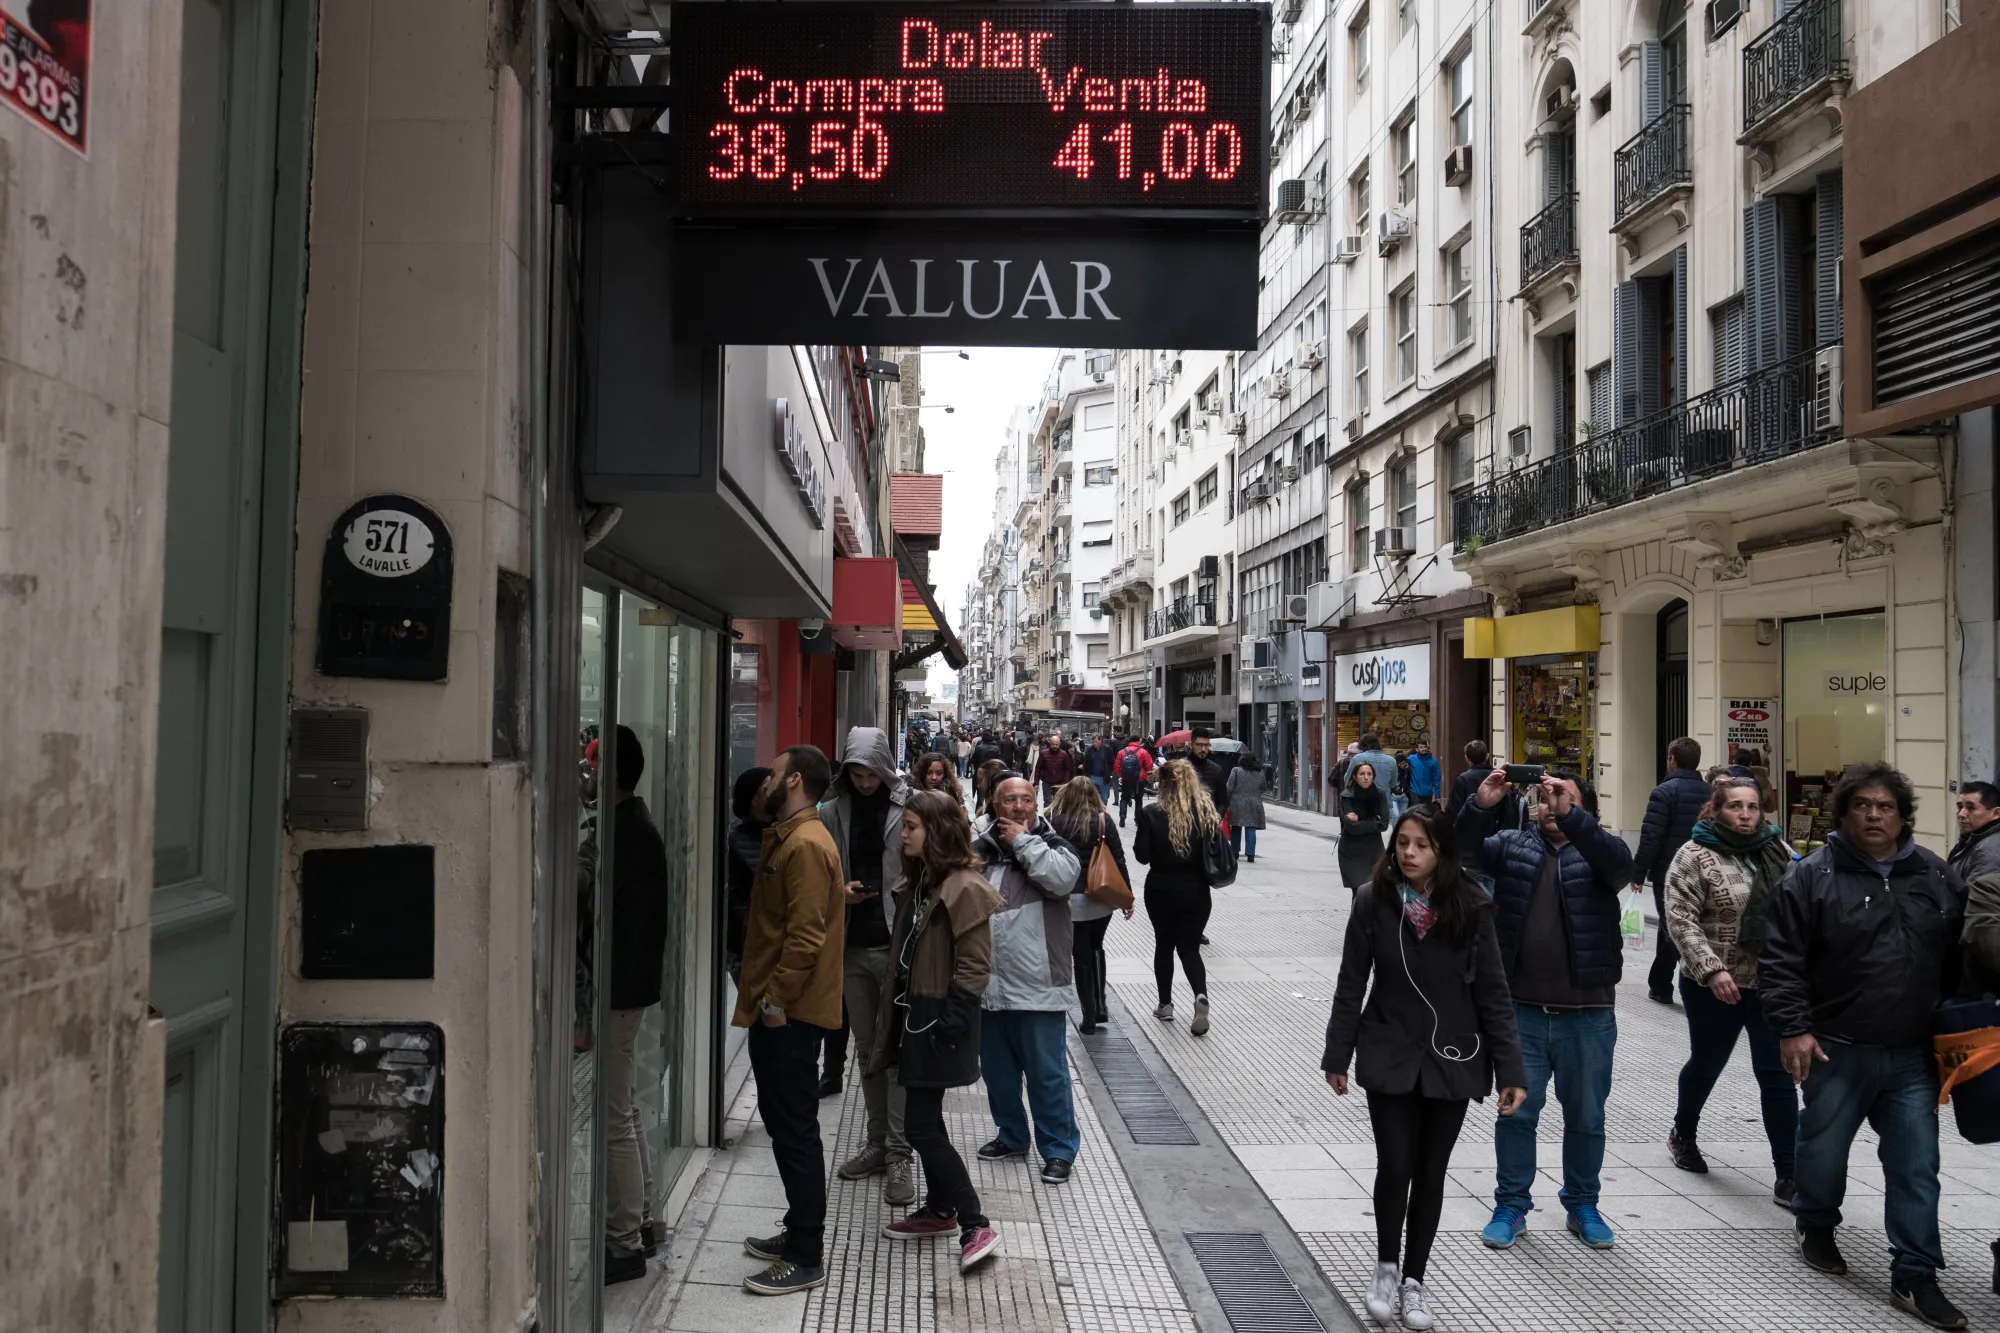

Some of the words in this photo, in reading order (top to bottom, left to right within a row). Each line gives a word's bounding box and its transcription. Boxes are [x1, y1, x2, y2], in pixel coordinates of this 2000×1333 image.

[18, 36, 80, 96] ALARMAS
[902, 18, 1053, 69] Dolar
[0, 43, 78, 136] 9393
[727, 68, 944, 122] Compra
[1037, 66, 1207, 112] Venta
[708, 122, 888, 191] 38,50
[1053, 122, 1241, 191] 41,00
[807, 257, 1121, 321] VALUAR
[365, 519, 409, 554] 571
[358, 555, 411, 572] LAVALLE
[1730, 700, 1768, 709] BAJE
[1829, 671, 1886, 695] suple
